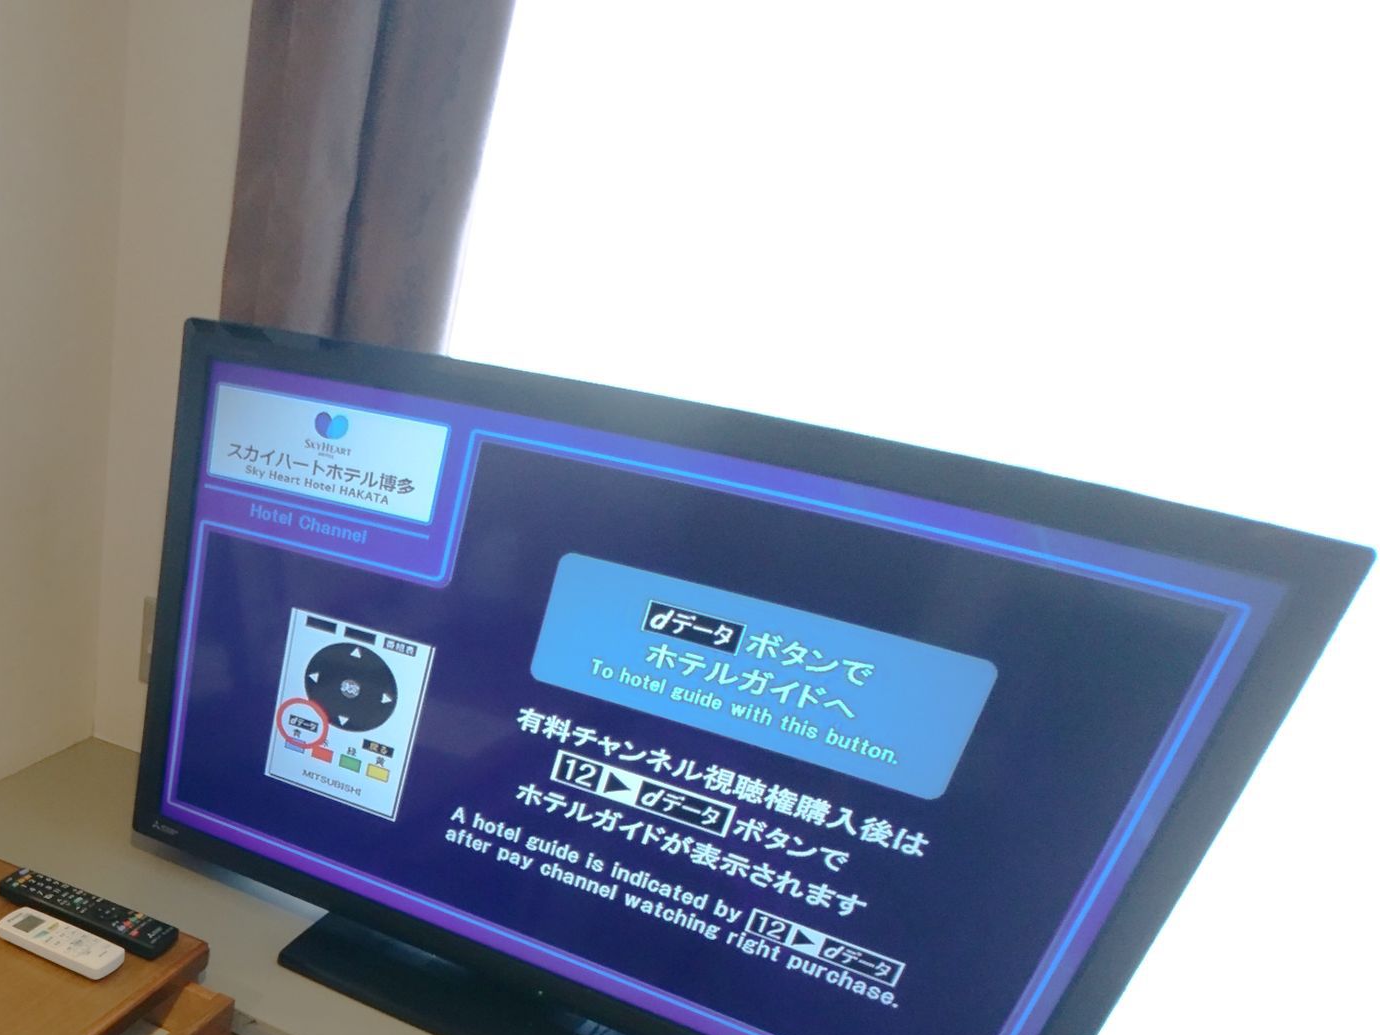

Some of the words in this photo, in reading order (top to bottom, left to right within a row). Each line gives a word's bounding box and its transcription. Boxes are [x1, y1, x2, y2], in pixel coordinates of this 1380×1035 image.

[227, 441, 415, 495] スカイハートホテル博多
[244, 464, 265, 479] Sky
[268, 469, 300, 485] Heart
[303, 477, 335, 492] Hotel
[339, 485, 388, 505] HAKATA
[250, 503, 292, 526] Hotel
[298, 514, 367, 544] Channel
[645, 643, 854, 717] ホテルガイドへ
[745, 632, 874, 685] ボタンで
[592, 658, 613, 678] To
[619, 667, 666, 694] hotel
[670, 686, 722, 709] guide
[731, 703, 772, 725] with
[780, 715, 817, 738] this
[825, 727, 897, 764] button.
[302, 770, 362, 796] MITSUBISHI
[516, 706, 929, 857] 有料チャンネル視聴権購入後は
[565, 759, 596, 787] 12
[732, 818, 849, 871] ボタンで
[450, 806, 464, 824] A
[472, 812, 521, 842] hotel
[525, 836, 579, 863] guide
[585, 852, 603, 872] is
[610, 861, 708, 910] indicated
[713, 898, 742, 922] by
[751, 913, 788, 942] 12
[516, 783, 866, 915] ホテルガイドが表示されます
[445, 828, 491, 853] after
[496, 847, 533, 869] pay
[539, 862, 618, 900] channel
[624, 892, 720, 940] watching
[726, 931, 783, 961] right
[785, 953, 898, 1008] purchase.
